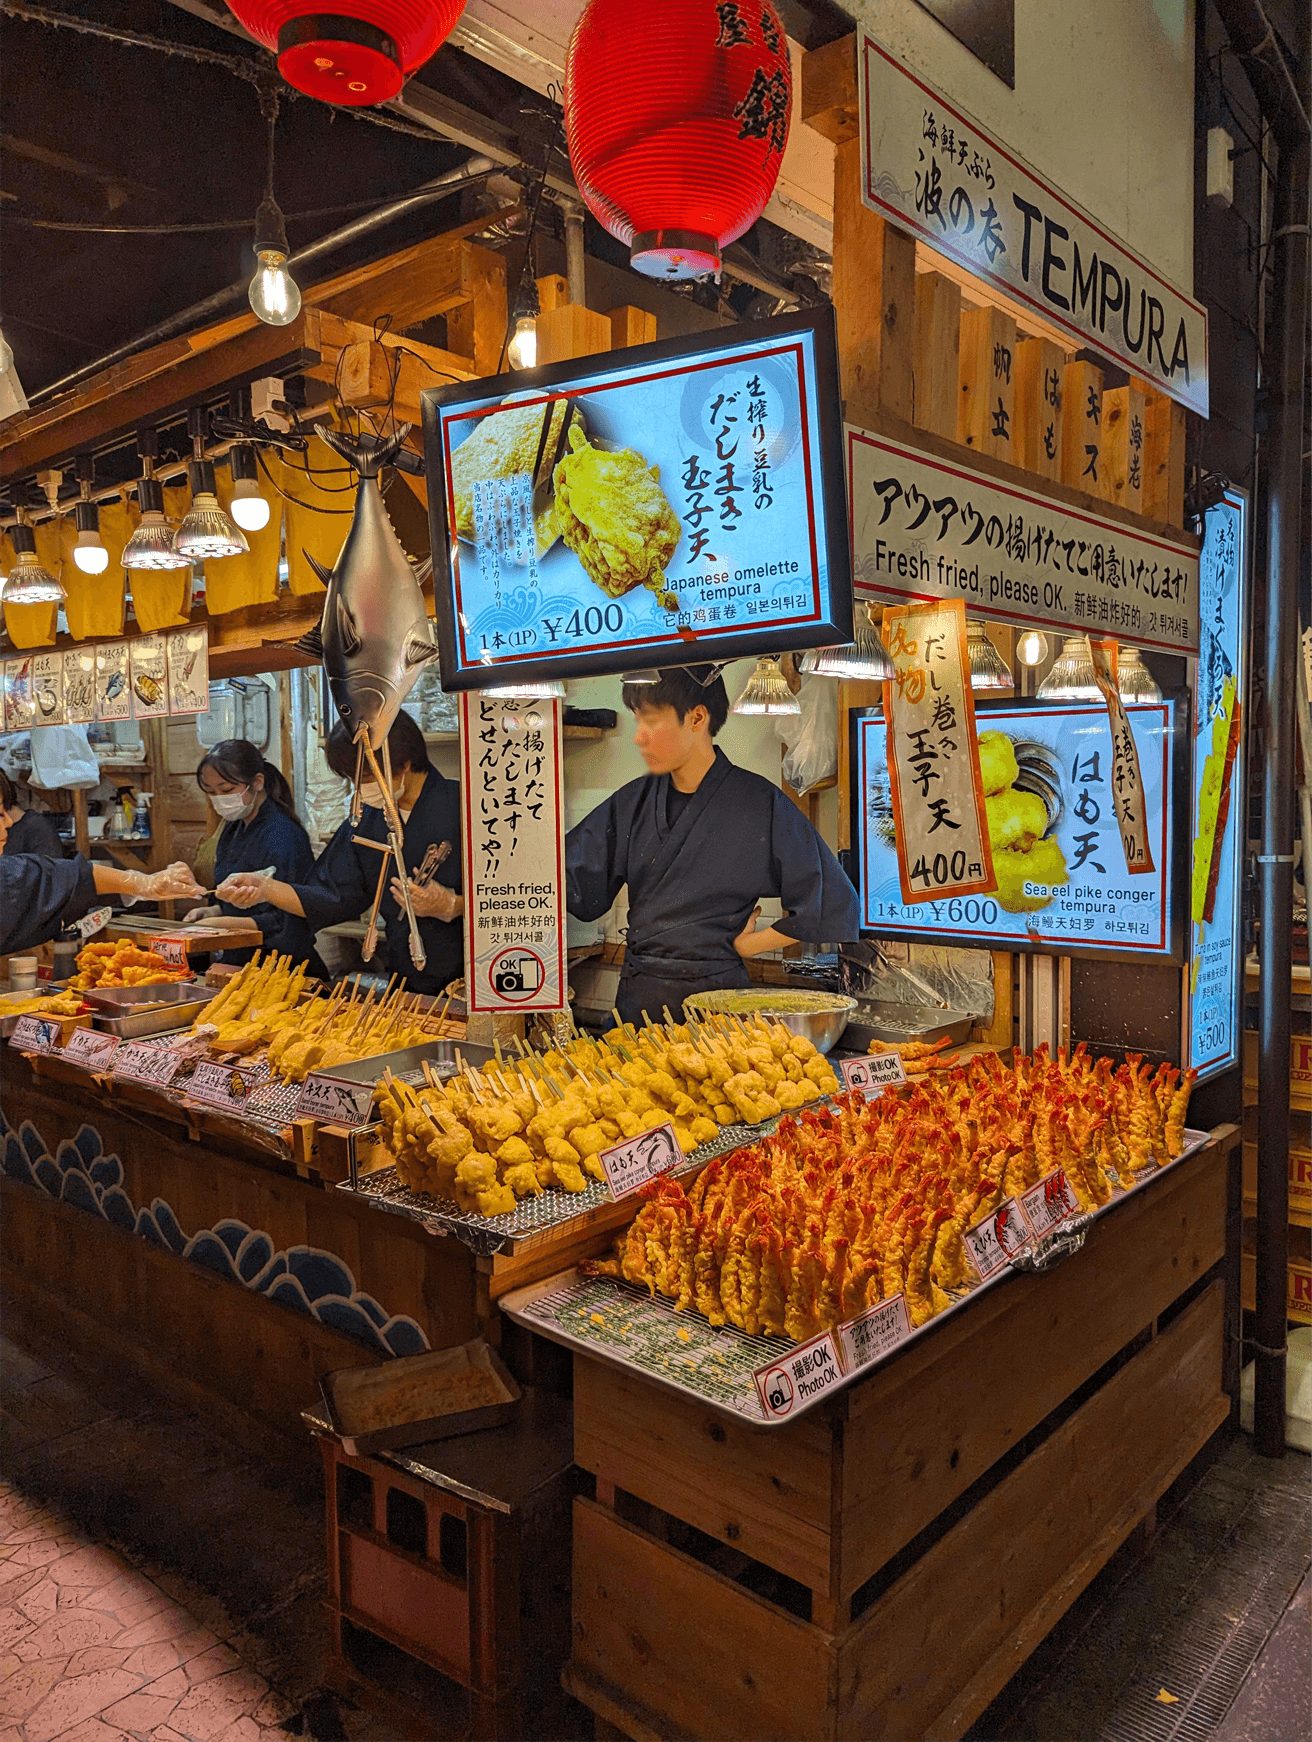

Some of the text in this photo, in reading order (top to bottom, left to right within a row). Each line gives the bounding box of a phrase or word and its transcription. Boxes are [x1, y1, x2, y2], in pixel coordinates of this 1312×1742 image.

[923, 109, 995, 189] 海鮮天ぷら
[1012, 191, 1191, 387] TEMPURA
[1044, 368, 1059, 460] はも
[746, 374, 774, 510] 生搾り豆乳の
[1082, 385, 1100, 482] キス
[710, 390, 744, 531] だしまき
[681, 455, 717, 564] 玉子天
[663, 561, 799, 592] Japanese omelette
[700, 582, 761, 601] tempura
[875, 539, 930, 582] Fresh
[937, 555, 984, 597] fried,
[989, 570, 1039, 605] please
[1043, 582, 1067, 612] OK.
[1074, 591, 1141, 629] 新鲜油炸好的
[480, 603, 623, 650] 1本(1P) ¥400
[663, 593, 807, 627] 它的鸡蛋卷 일본의튀김
[925, 633, 958, 759] だし巻き
[906, 728, 962, 834] 玉子天
[1068, 752, 1107, 873] はも天
[911, 850, 982, 887] 400円
[476, 882, 555, 896] Fresh fried,
[480, 897, 553, 912] please OK.
[1025, 882, 1155, 903] Sea eel pike conger
[478, 915, 555, 929] 新鲜油炸好的
[877, 899, 998, 925] 1本(1P) ¥600
[1060, 900, 1116, 914] tempura
[490, 933, 500, 944] 갓
[1028, 915, 1149, 934] 海鳗天妇罗 하모튀김
[169, 948, 185, 964] hot
[500, 959, 517, 970] OK
[1199, 1022, 1225, 1054] ¥500
[306, 1082, 332, 1100] キス天
[872, 1070, 901, 1083] Photo OK
[609, 1150, 638, 1174] はも天
[792, 1344, 832, 1381] 撮影OK
[798, 1364, 838, 1400] Photo OK
